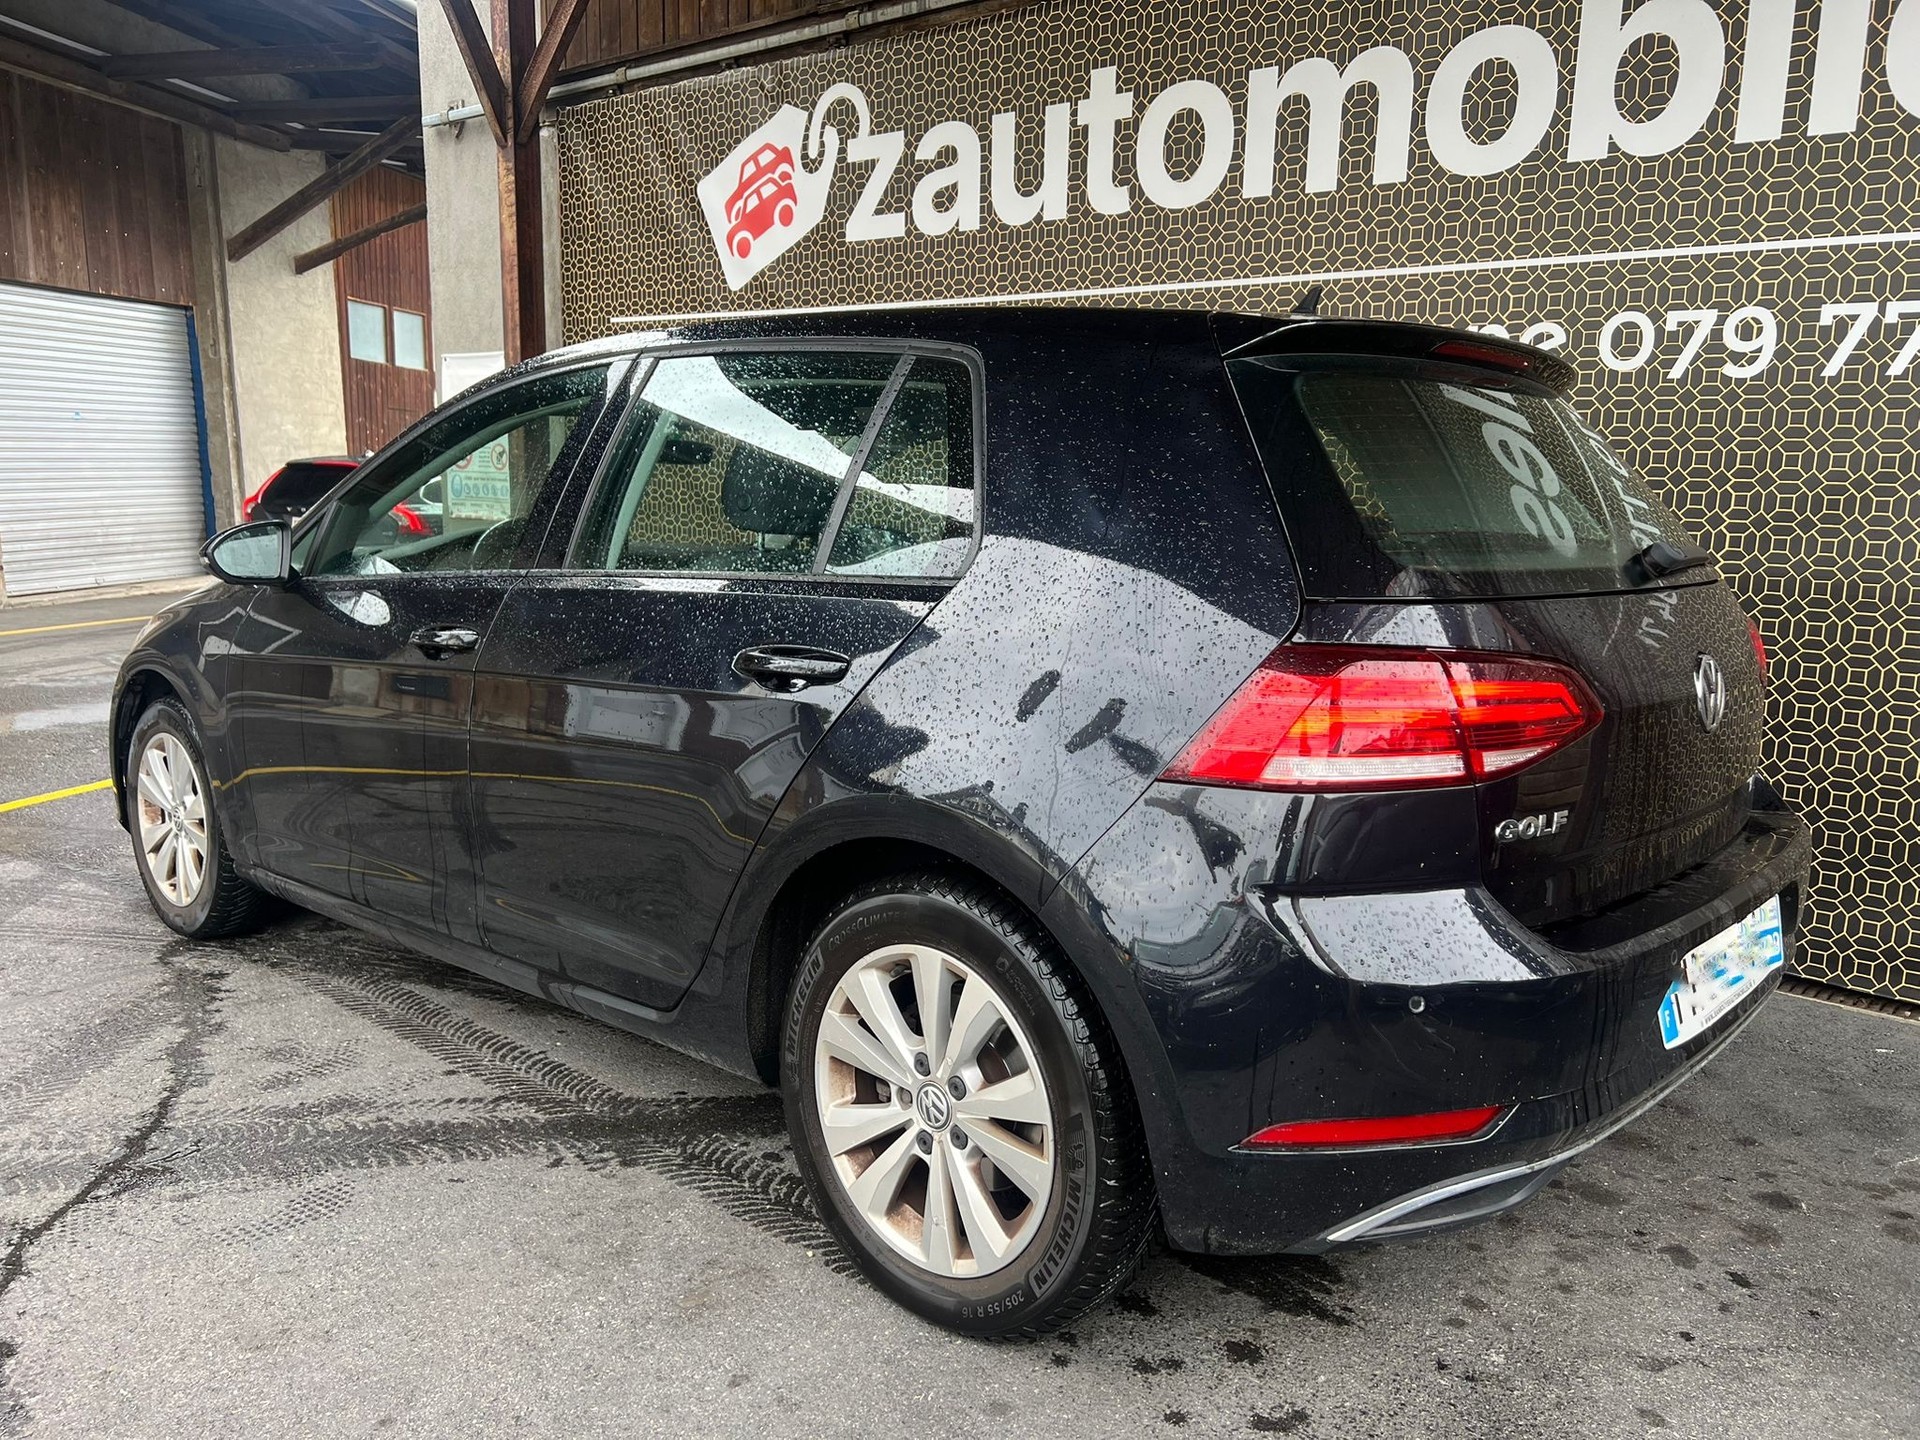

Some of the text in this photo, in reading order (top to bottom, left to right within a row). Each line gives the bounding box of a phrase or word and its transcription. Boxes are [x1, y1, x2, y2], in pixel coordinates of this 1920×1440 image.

[844, 0, 1920, 242] zautomobil
[1600, 306, 1778, 379] 079
[1494, 809, 1569, 842] GOLF
[786, 952, 822, 1056] MICHELIN
[1033, 1175, 1082, 1290] MICHELIN
[962, 1307, 973, 1318] 16
[987, 1290, 1025, 1315] 205/55
